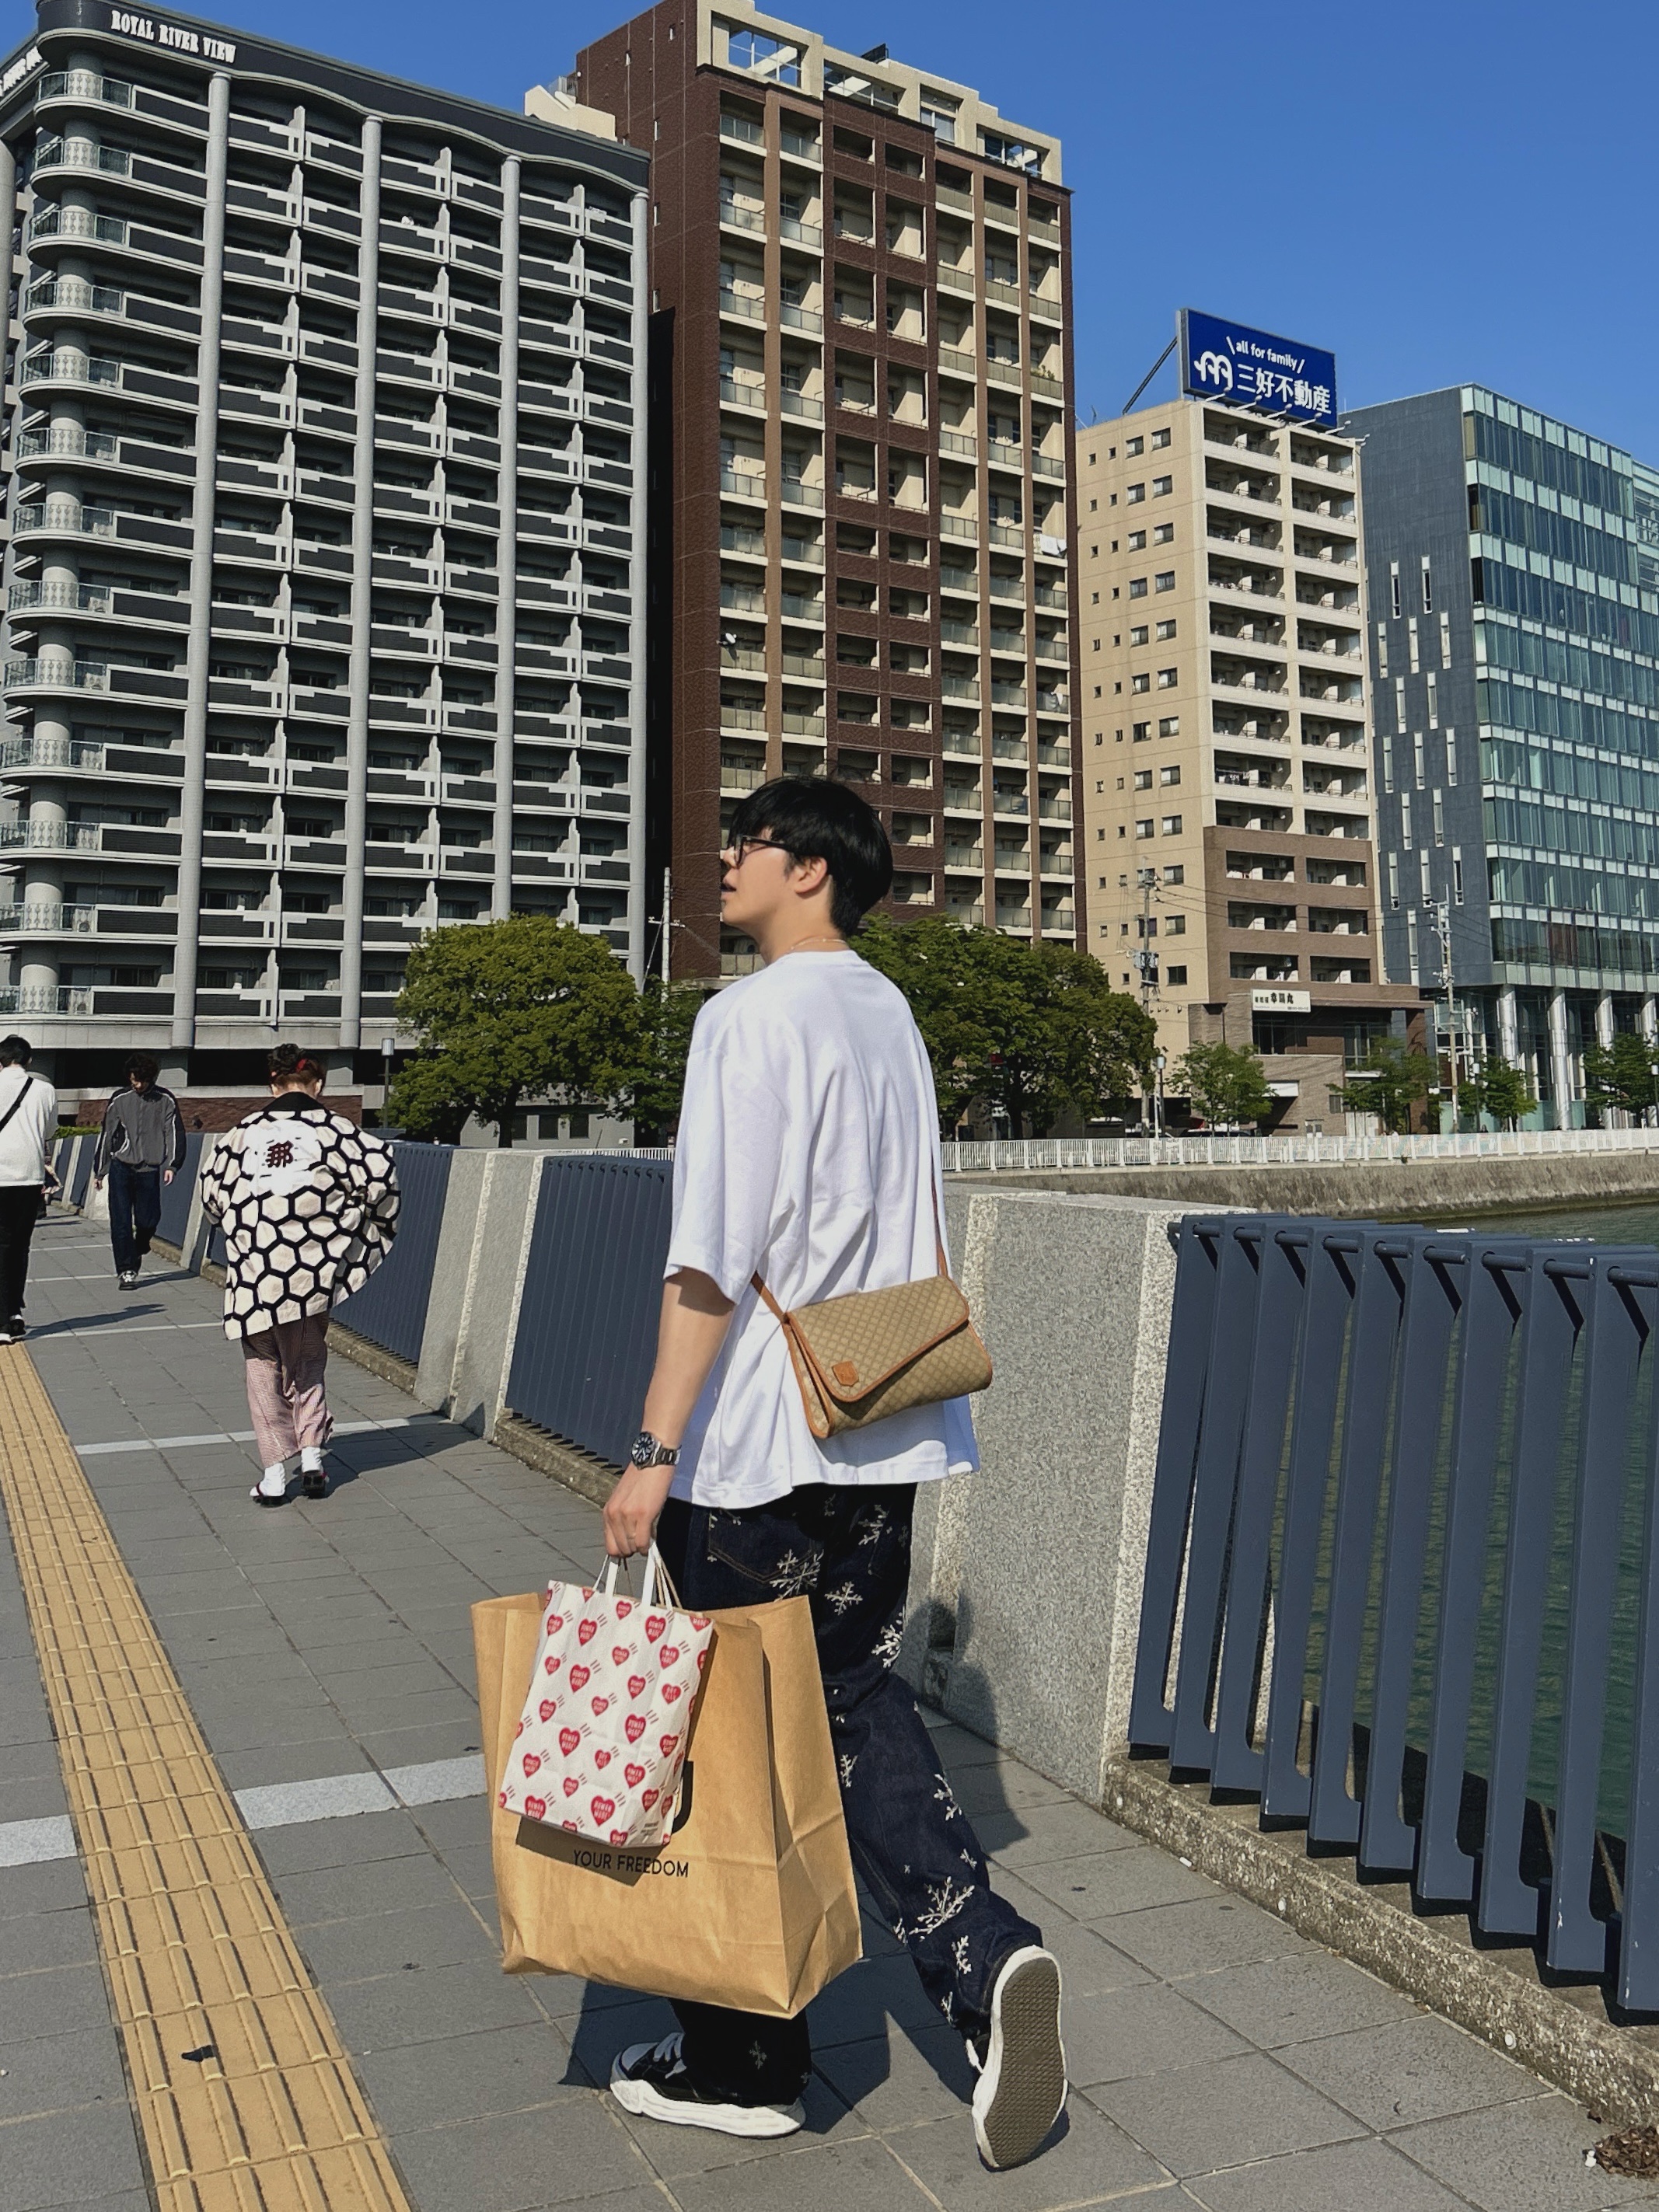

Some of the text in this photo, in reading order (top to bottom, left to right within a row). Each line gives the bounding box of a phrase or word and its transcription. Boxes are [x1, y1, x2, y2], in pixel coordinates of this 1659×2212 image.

[111, 10, 236, 64] ROYAL RIVER VIEW
[1236, 340, 1298, 371] all for family
[1237, 363, 1332, 414] 三好不動産
[574, 1849, 689, 1878] YOUR FREEDOM
